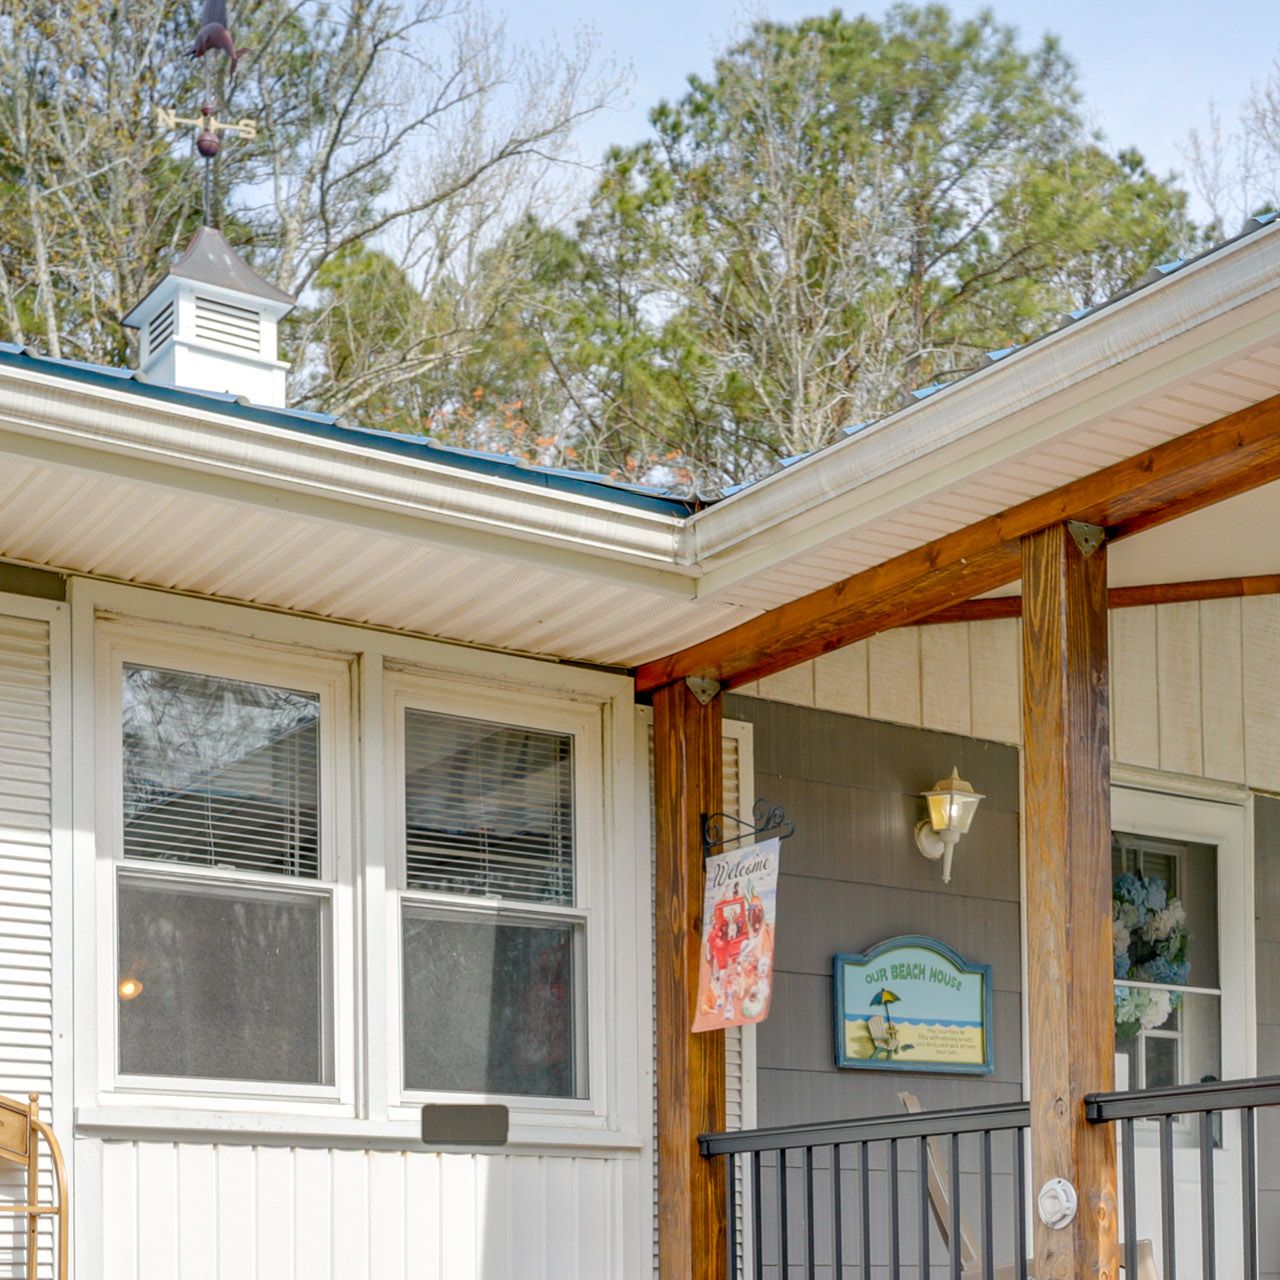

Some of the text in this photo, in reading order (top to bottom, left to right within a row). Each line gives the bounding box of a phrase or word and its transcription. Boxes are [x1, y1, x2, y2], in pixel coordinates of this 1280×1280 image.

[156, 108, 176, 129] N
[239, 119, 257, 139] S
[713, 857, 770, 889] Welcome
[864, 963, 962, 992] OUR BEACH HOUSE
